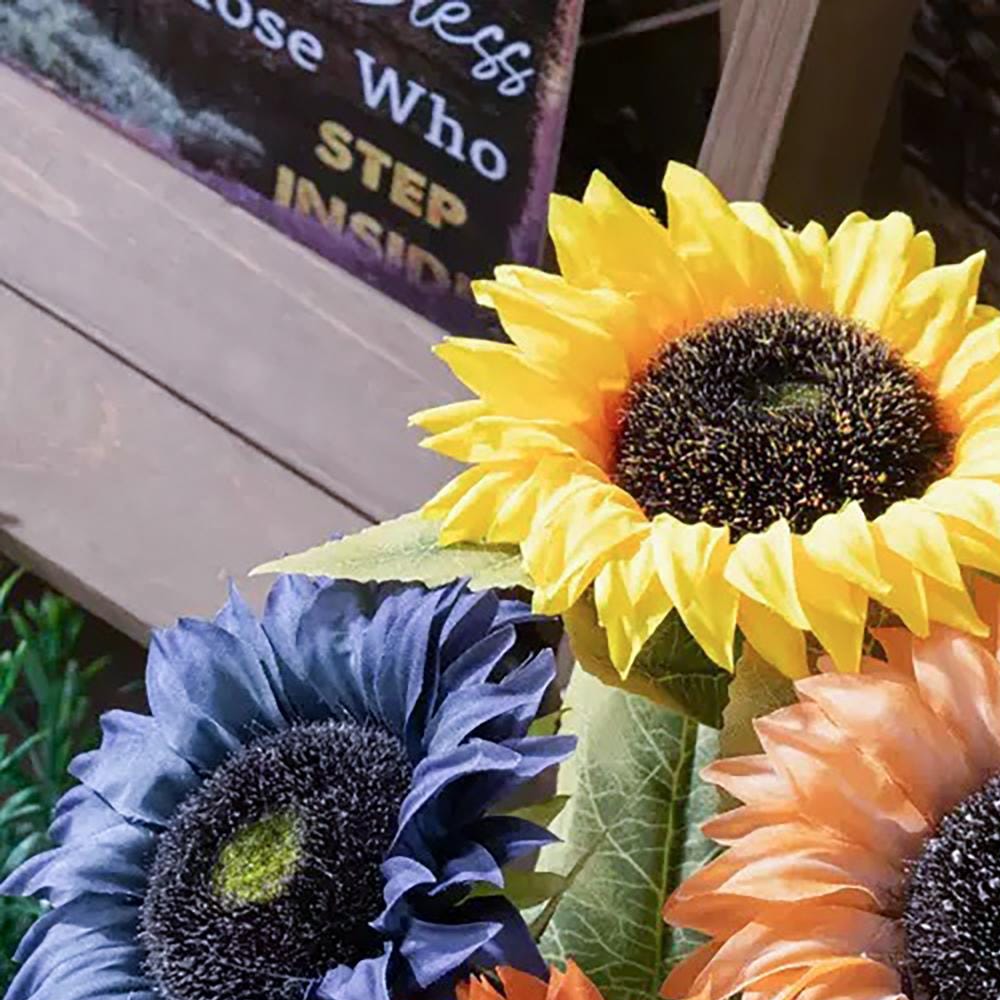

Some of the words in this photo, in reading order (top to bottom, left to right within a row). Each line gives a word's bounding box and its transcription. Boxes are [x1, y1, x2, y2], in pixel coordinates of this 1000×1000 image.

[191, 0, 324, 72] ose
[354, 48, 508, 181] Who
[352, 0, 535, 96] ess
[315, 119, 468, 230] STEP
